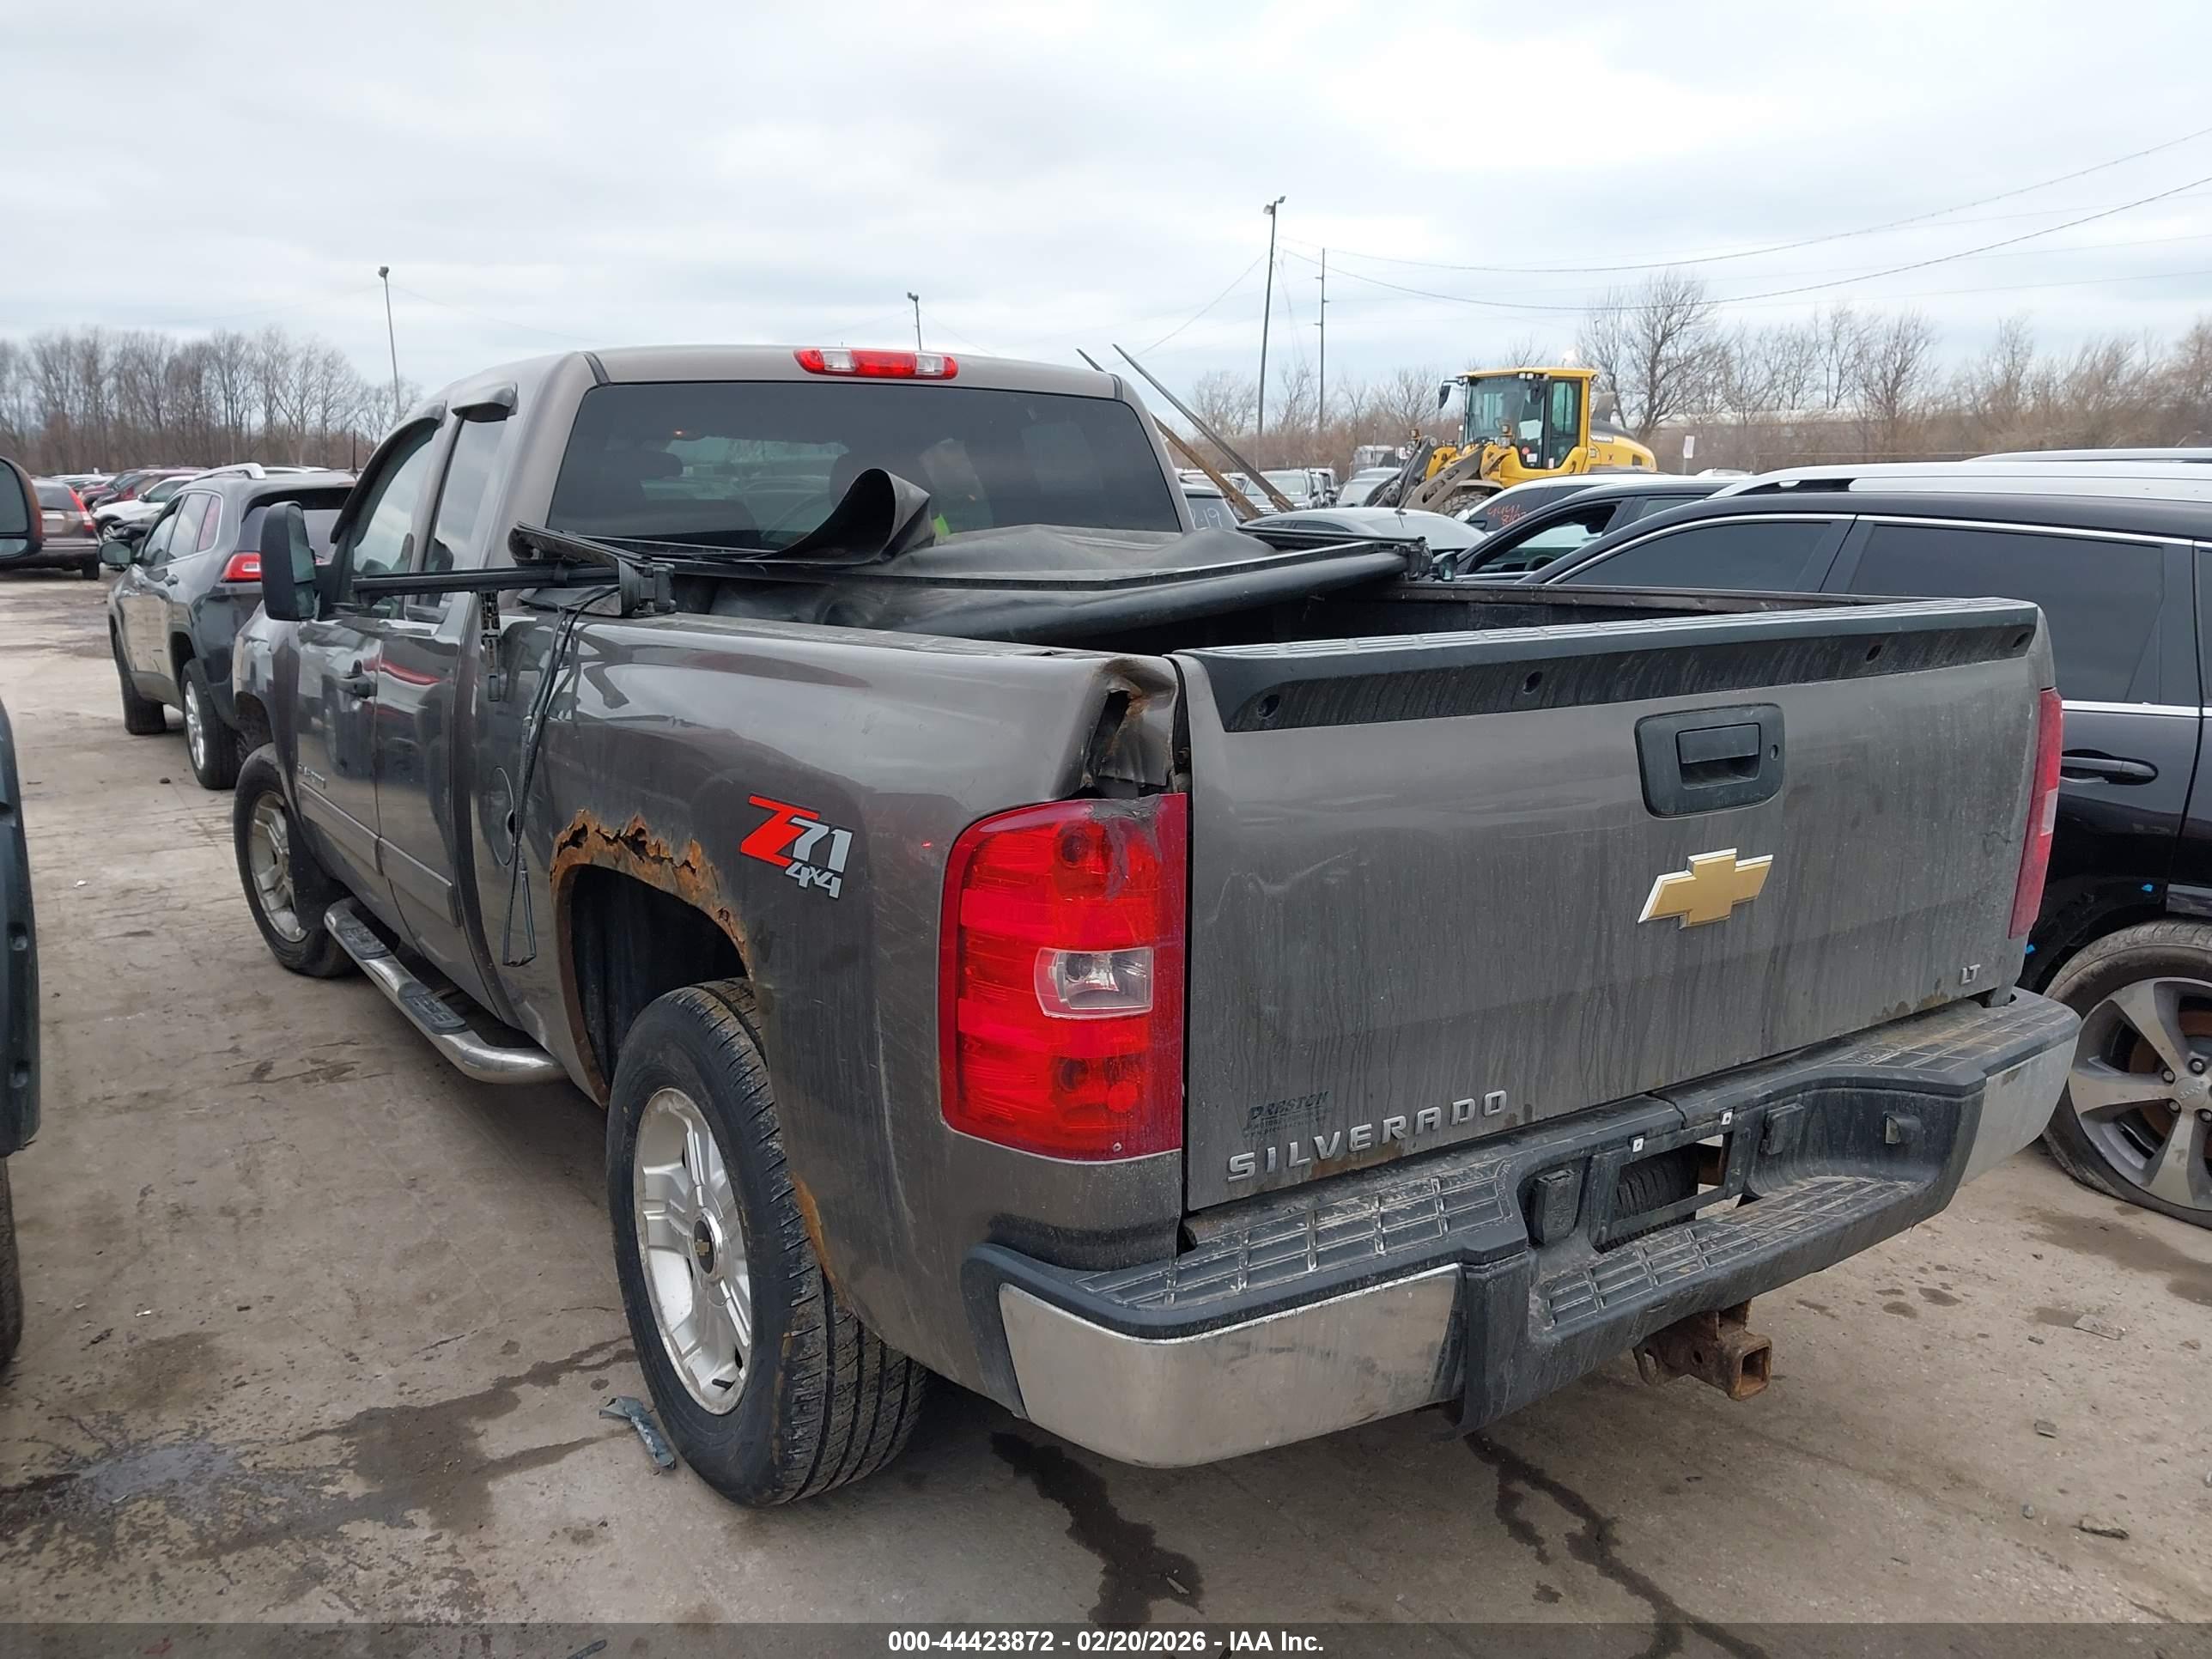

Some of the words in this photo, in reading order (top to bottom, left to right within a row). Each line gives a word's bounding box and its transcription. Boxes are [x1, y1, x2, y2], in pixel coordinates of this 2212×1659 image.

[739, 794, 854, 873] Z71
[1960, 963, 1981, 985] LT
[1227, 1090, 1507, 1182] SILVERADO
